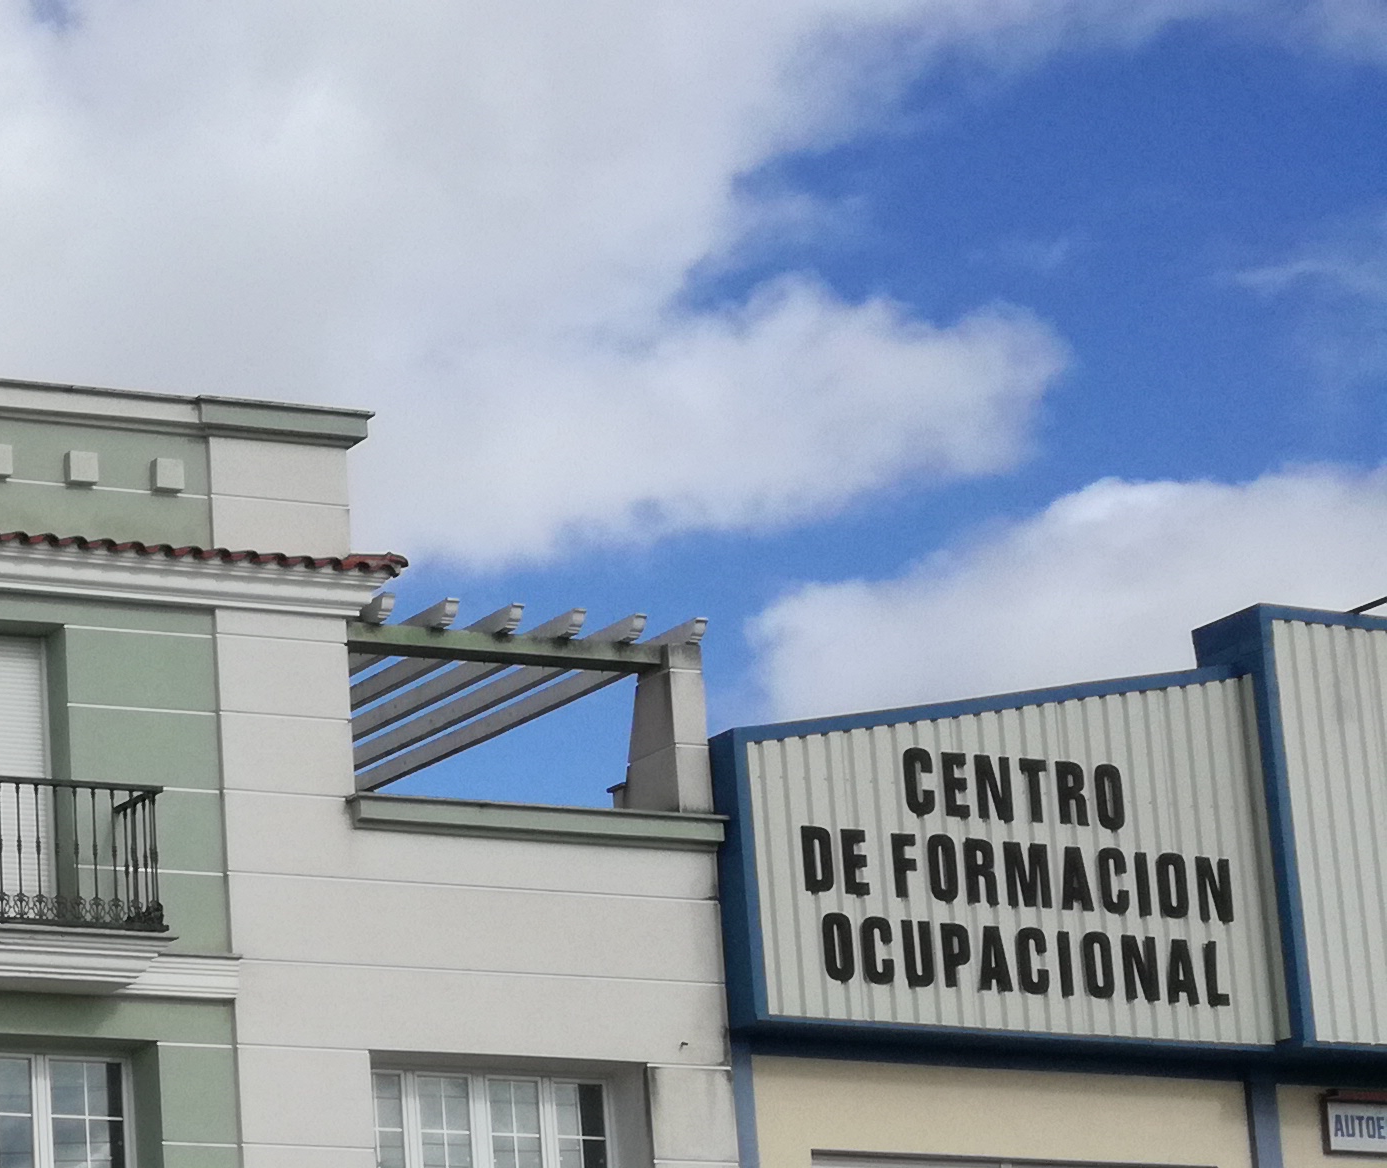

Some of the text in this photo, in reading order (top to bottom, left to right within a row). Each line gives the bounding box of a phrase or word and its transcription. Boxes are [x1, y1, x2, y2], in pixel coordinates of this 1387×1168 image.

[902, 746, 1126, 832] CENTRO
[800, 824, 1235, 925] DE FORMACION
[821, 911, 1231, 1008] OCUPACIONAL
